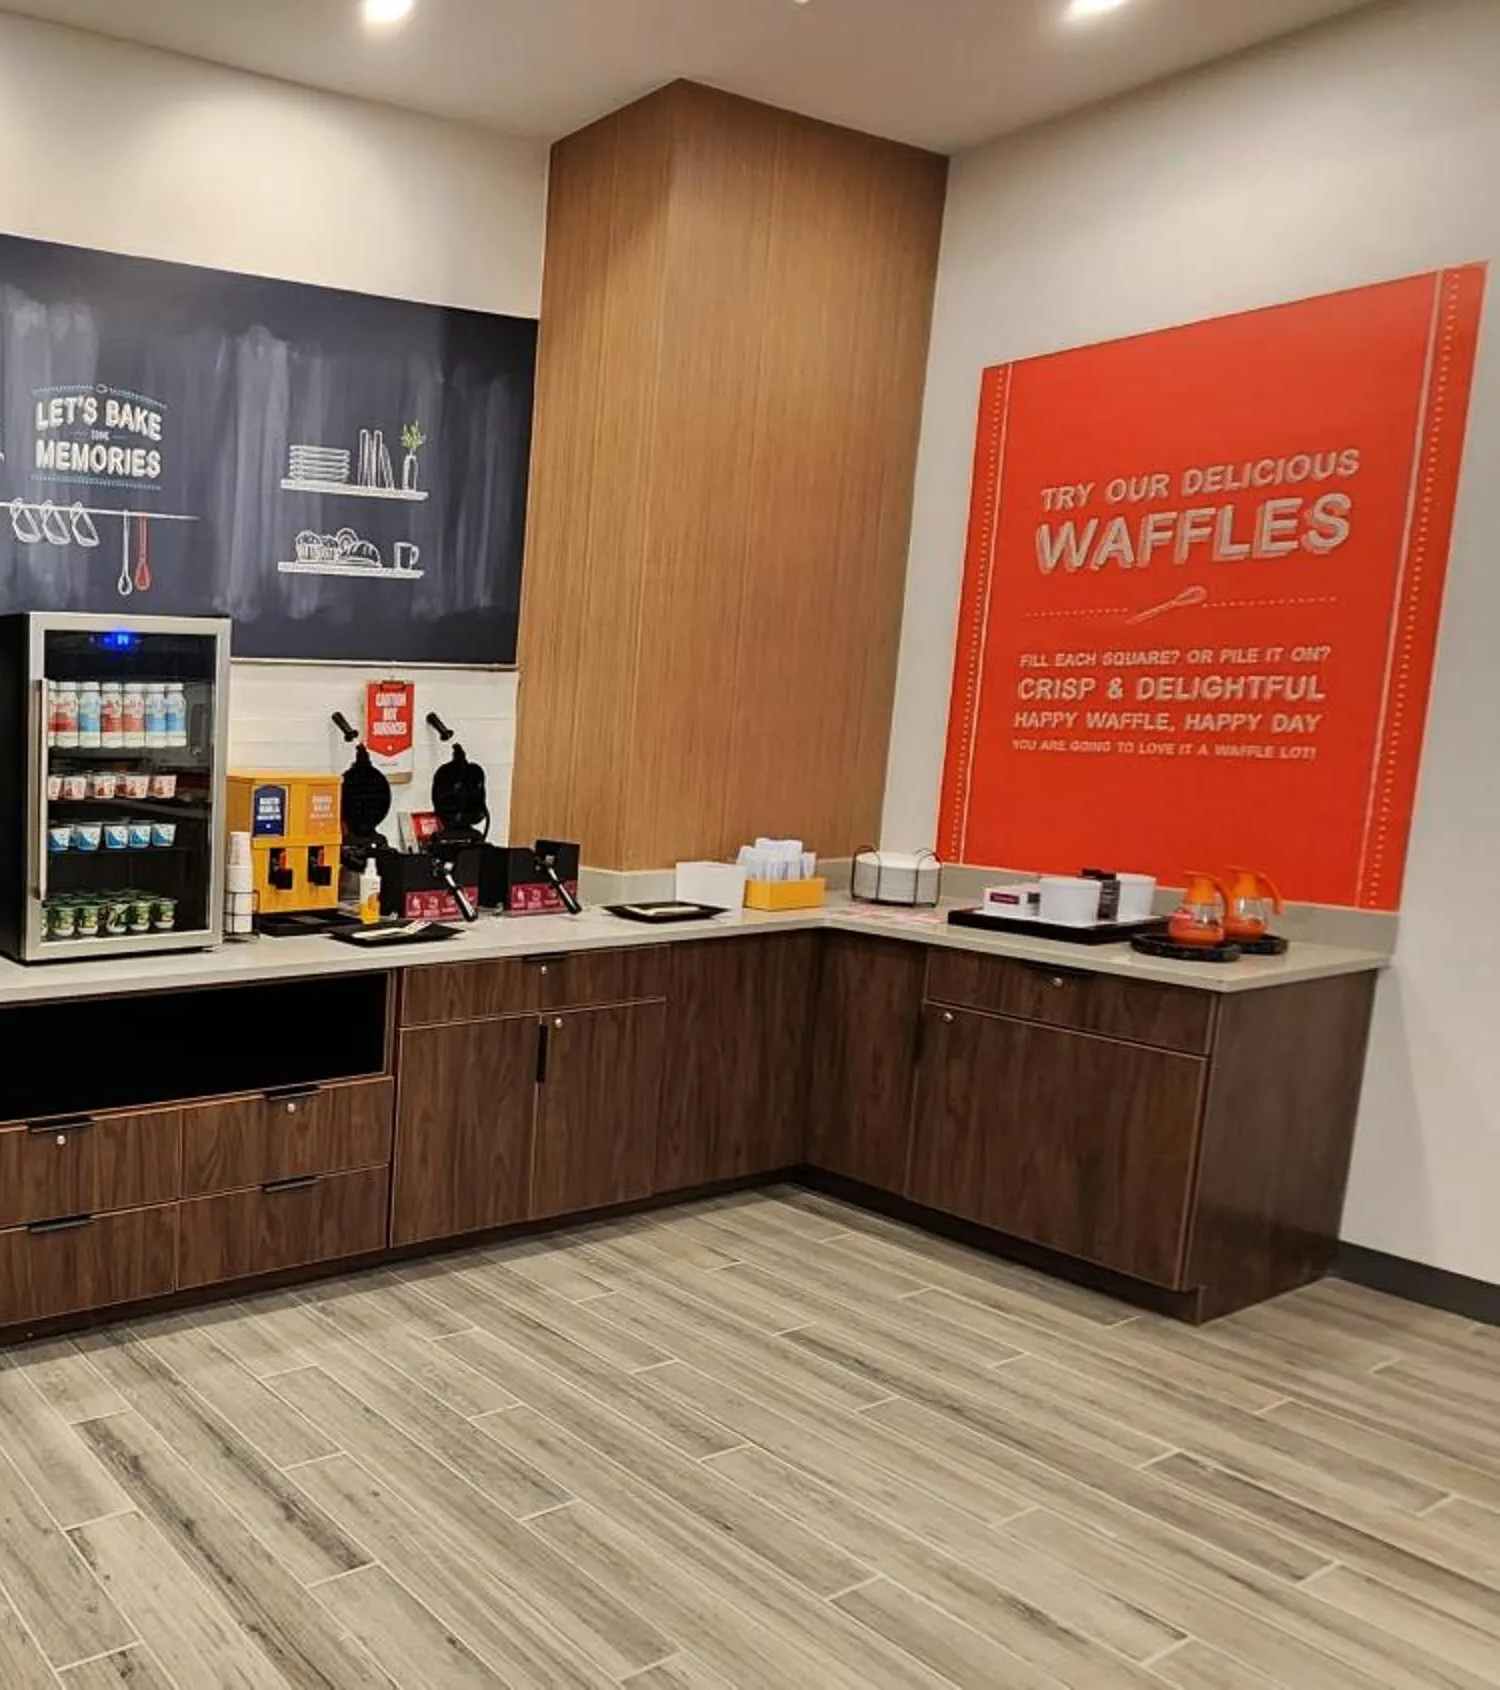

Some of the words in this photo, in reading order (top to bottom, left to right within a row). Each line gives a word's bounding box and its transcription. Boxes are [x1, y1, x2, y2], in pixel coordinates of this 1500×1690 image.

[35, 395, 98, 431] LET'S
[105, 399, 162, 441] BAKE
[35, 439, 161, 479] MEMORIES
[1041, 481, 1096, 512] TRY
[1105, 473, 1170, 504] OUR
[1180, 448, 1360, 497] DELICIOUS
[1035, 492, 1353, 575] WAFFLES
[1019, 653, 1049, 668] FILL
[1055, 652, 1097, 667] EACH
[1102, 649, 1180, 667] SQUARE?
[1187, 649, 1213, 664] OR
[1219, 647, 1259, 663] PILE
[1265, 647, 1284, 662] IT
[1291, 645, 1331, 662] ON?
[1017, 677, 1097, 701] CRISP
[1107, 676, 1125, 700] &
[1136, 675, 1327, 701] DELIGHTFUL
[1013, 711, 1078, 729] HAPPY
[1085, 712, 1176, 733] WAFFLE,
[1184, 713, 1263, 732] HAPPY
[1271, 713, 1323, 733] DAY
[1011, 738, 1037, 750] YOU
[1039, 739, 1067, 752] ARE
[1069, 740, 1111, 753] GOING
[1116, 741, 1134, 753] TO
[1139, 742, 1175, 755] LOVE
[1178, 743, 1194, 755] IT
[1197, 743, 1209, 756] A
[1214, 743, 1274, 759] WAFFLE
